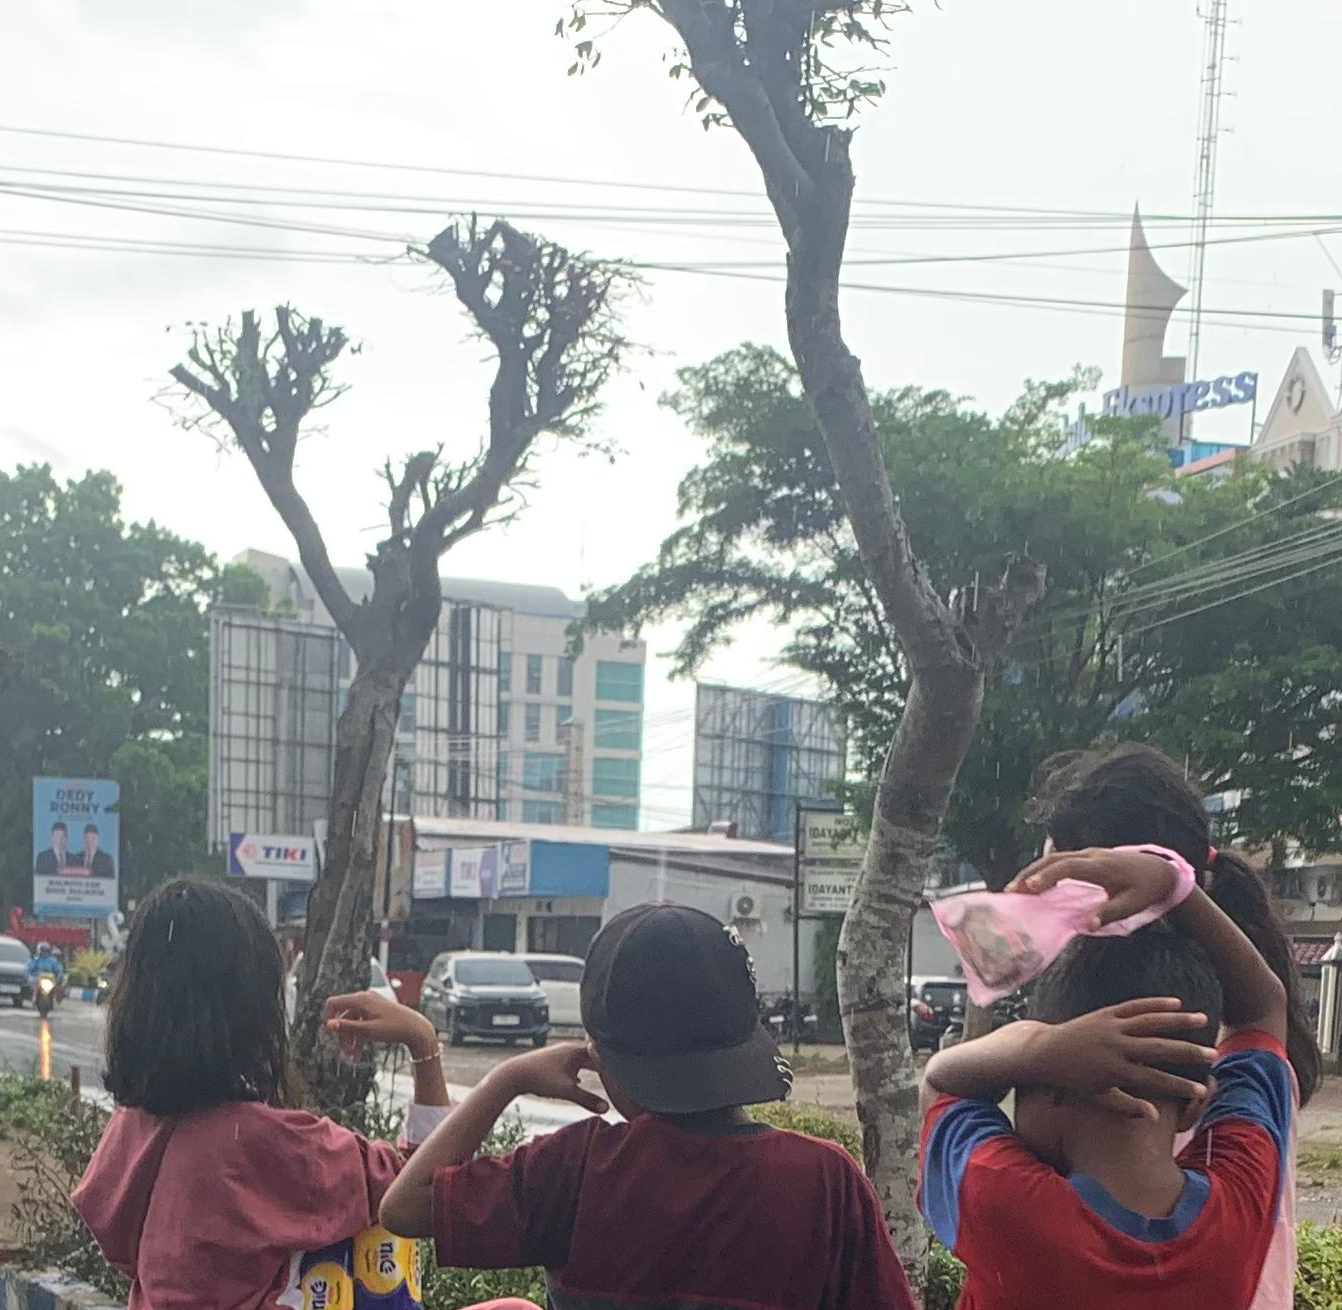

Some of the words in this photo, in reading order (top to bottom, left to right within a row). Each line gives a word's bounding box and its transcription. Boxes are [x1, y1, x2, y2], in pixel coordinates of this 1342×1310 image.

[55, 789, 95, 802] DEDY
[263, 846, 308, 861] TIKI
[808, 884, 854, 895] IDAYANT
